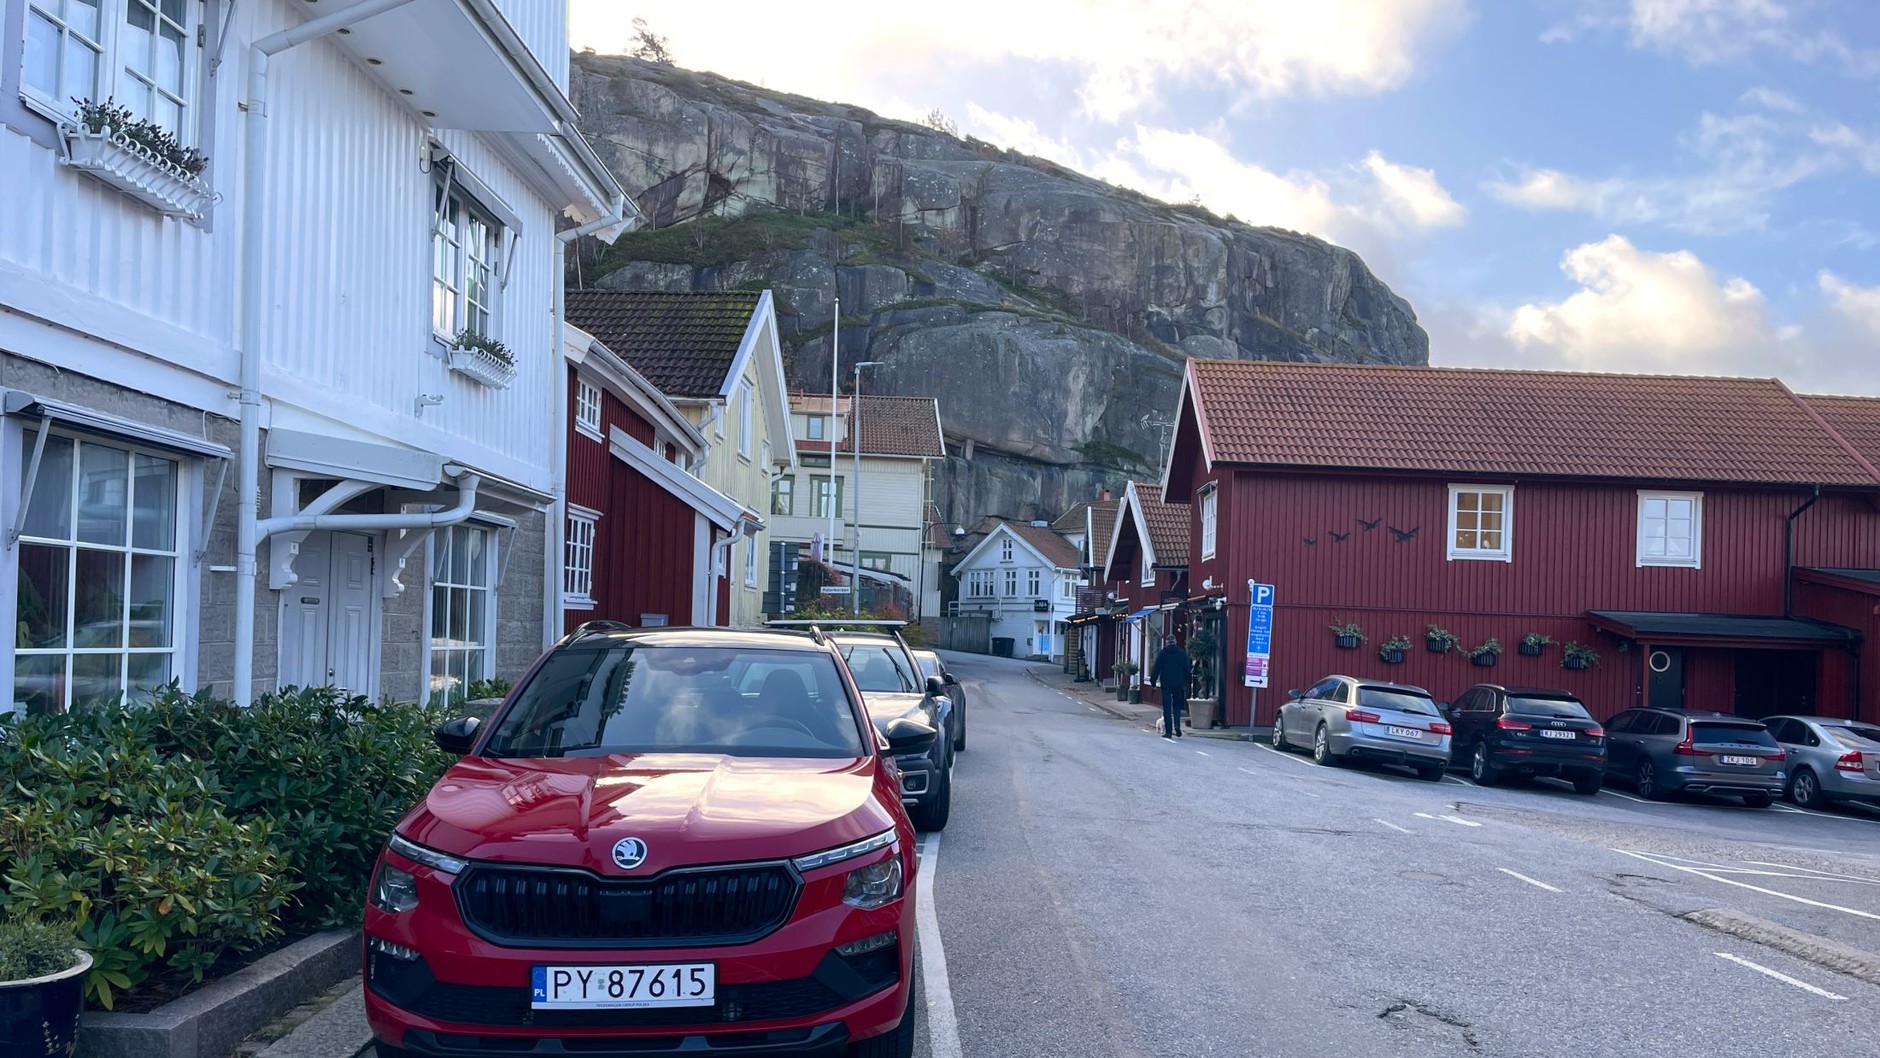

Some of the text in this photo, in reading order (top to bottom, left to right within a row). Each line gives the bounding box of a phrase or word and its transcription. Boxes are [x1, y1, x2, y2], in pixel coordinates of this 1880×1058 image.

[1257, 586, 1270, 603] P
[1391, 727, 1419, 737] LKY 067
[553, 968, 706, 999] PY 87615
[534, 988, 545, 997] PL
